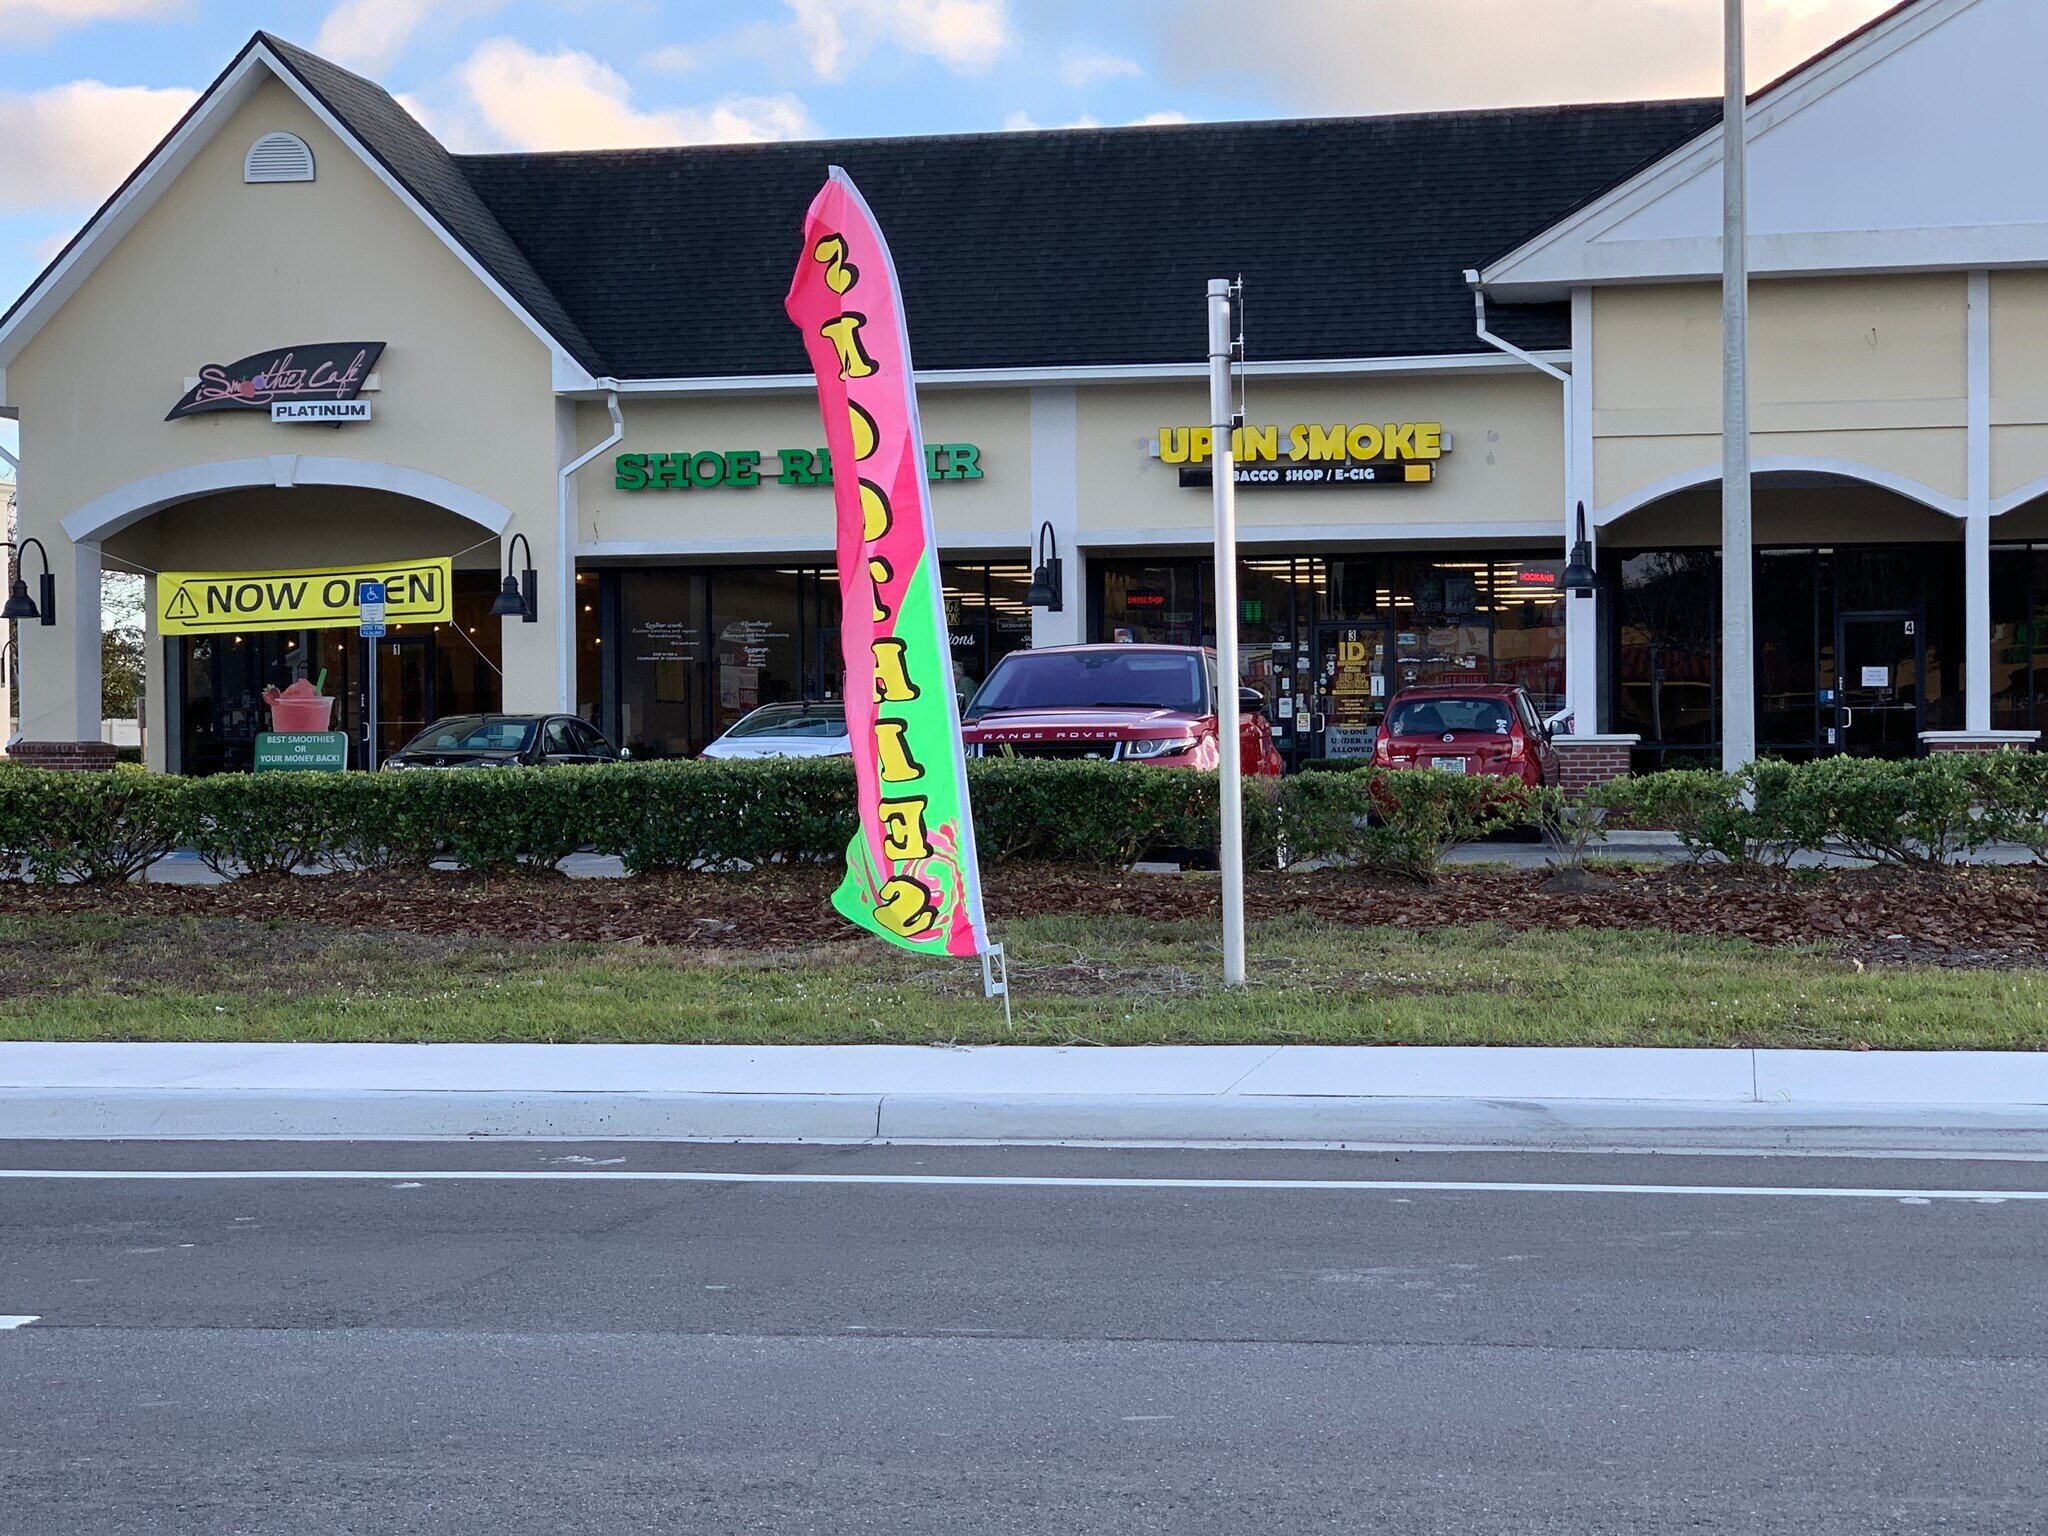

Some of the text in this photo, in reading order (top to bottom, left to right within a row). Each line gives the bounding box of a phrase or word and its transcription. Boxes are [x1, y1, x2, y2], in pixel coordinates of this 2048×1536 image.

[276, 405, 366, 417] PLATINUM
[1159, 422, 1441, 463] UP IN SMOKE
[615, 450, 761, 490] SHOE
[1233, 469, 1279, 482] BACCO
[1285, 469, 1324, 482] SHOP
[1335, 468, 1375, 480] E-CIG
[207, 581, 308, 614] NOW
[1905, 621, 1914, 634] 4
[1349, 630, 1356, 641] 3
[1339, 642, 1365, 660] ID
[267, 735, 335, 743] BEST SMOOTHIES
[294, 745, 307, 753] OR
[284, 754, 314, 762] MONEY
[316, 754, 340, 762] BACK!
